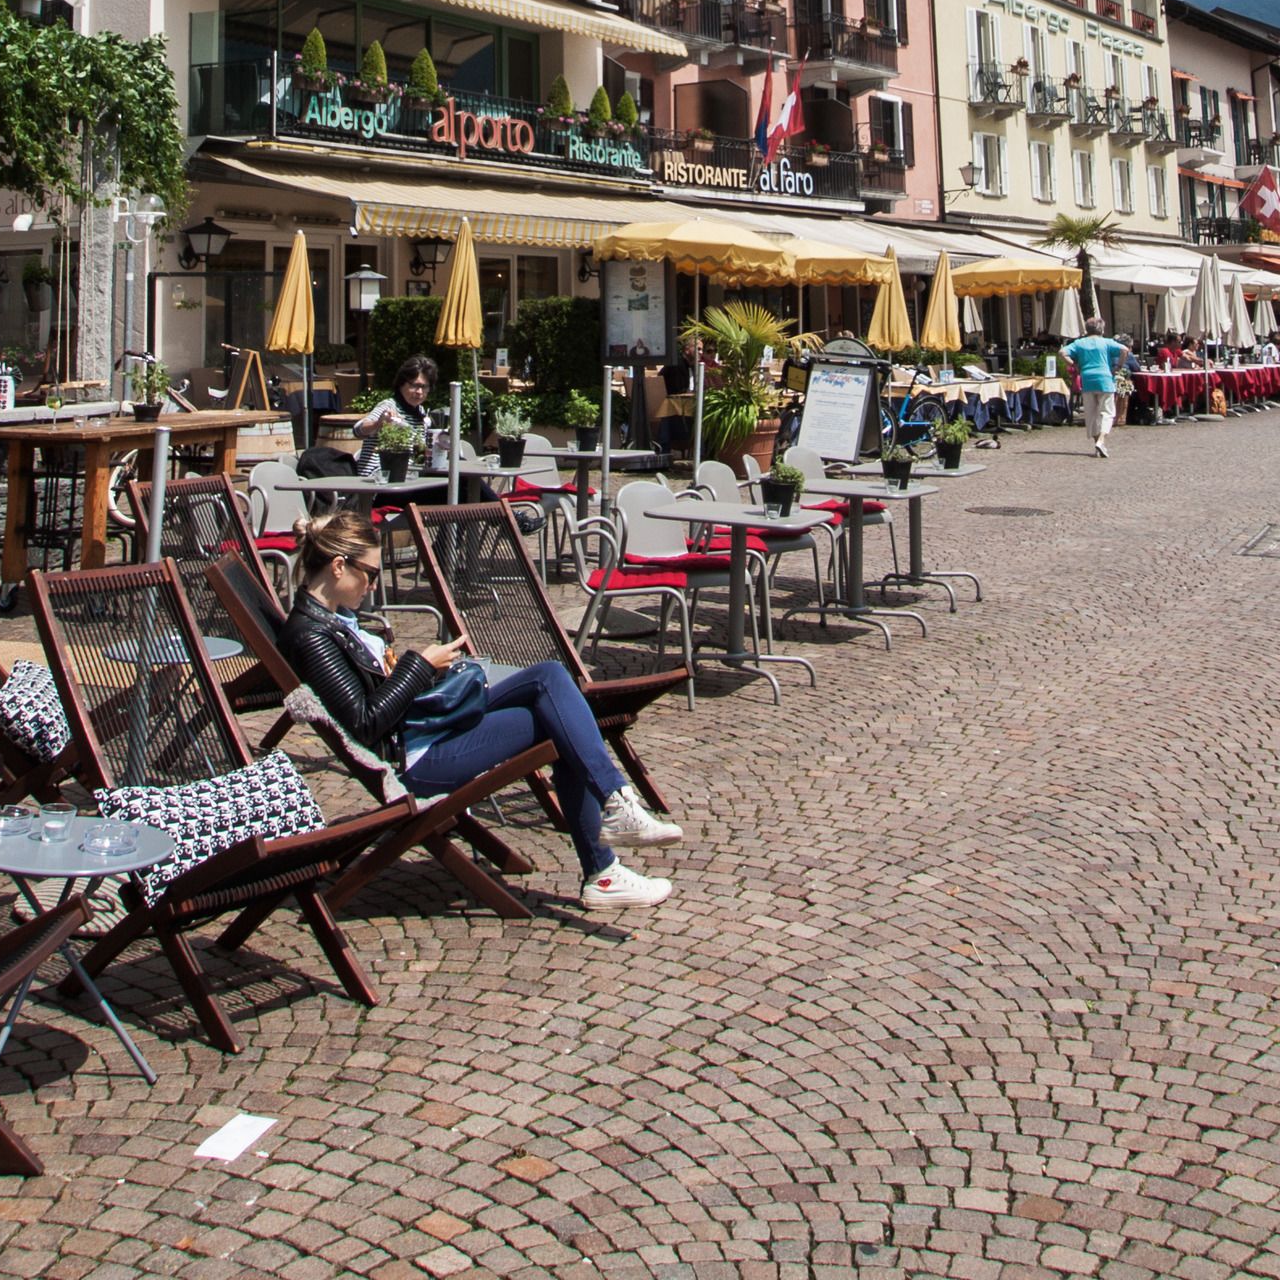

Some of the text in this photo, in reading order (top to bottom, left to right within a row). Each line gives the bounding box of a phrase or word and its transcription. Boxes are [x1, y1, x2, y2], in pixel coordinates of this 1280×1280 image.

[1083, 19, 1146, 58] Piazza
[304, 95, 643, 170] Albergo al porto Ristorante
[663, 161, 748, 189] RISTORANTE
[780, 157, 814, 196] faro
